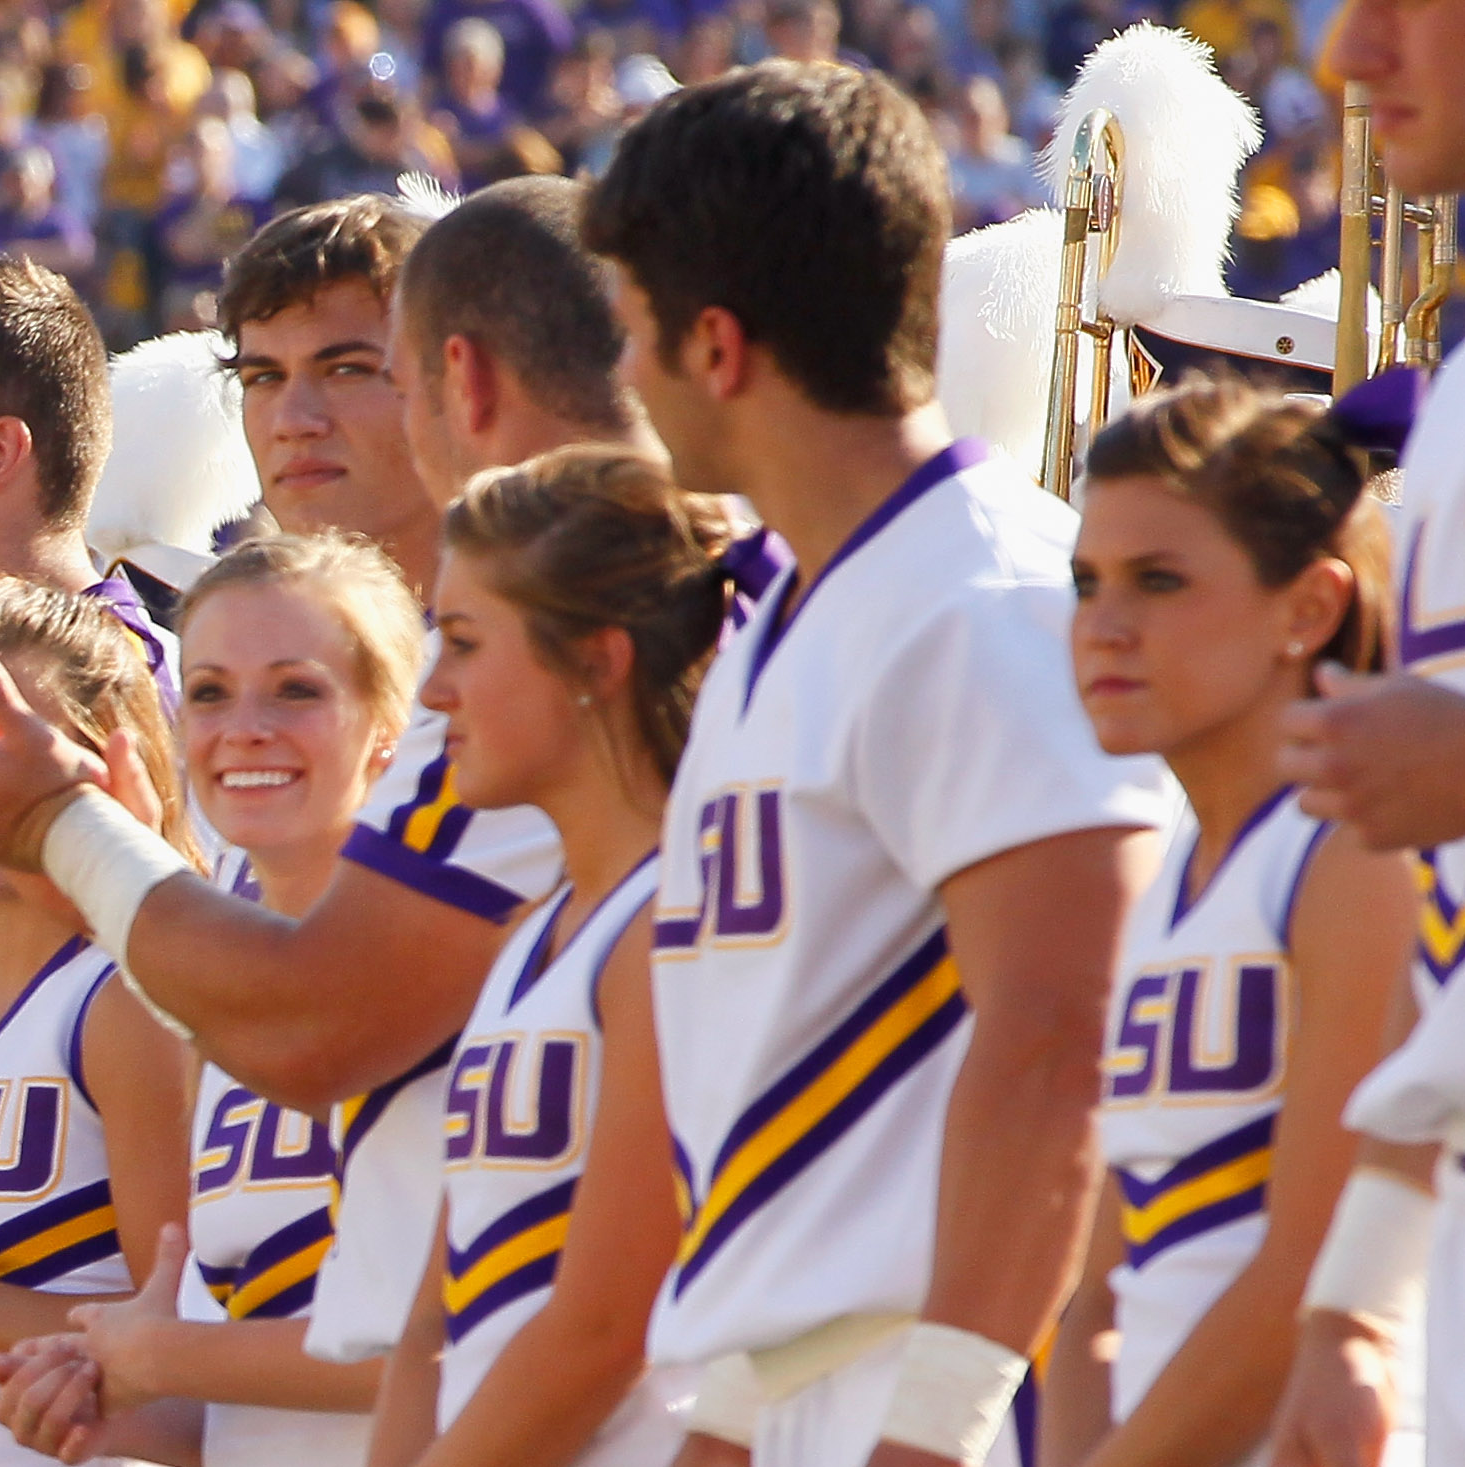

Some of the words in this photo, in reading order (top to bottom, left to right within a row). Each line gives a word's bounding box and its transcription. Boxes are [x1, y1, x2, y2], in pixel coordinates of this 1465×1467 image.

[445, 1029, 590, 1174] SU
[1097, 948, 1295, 1113] SU
[190, 1080, 343, 1208] SU
